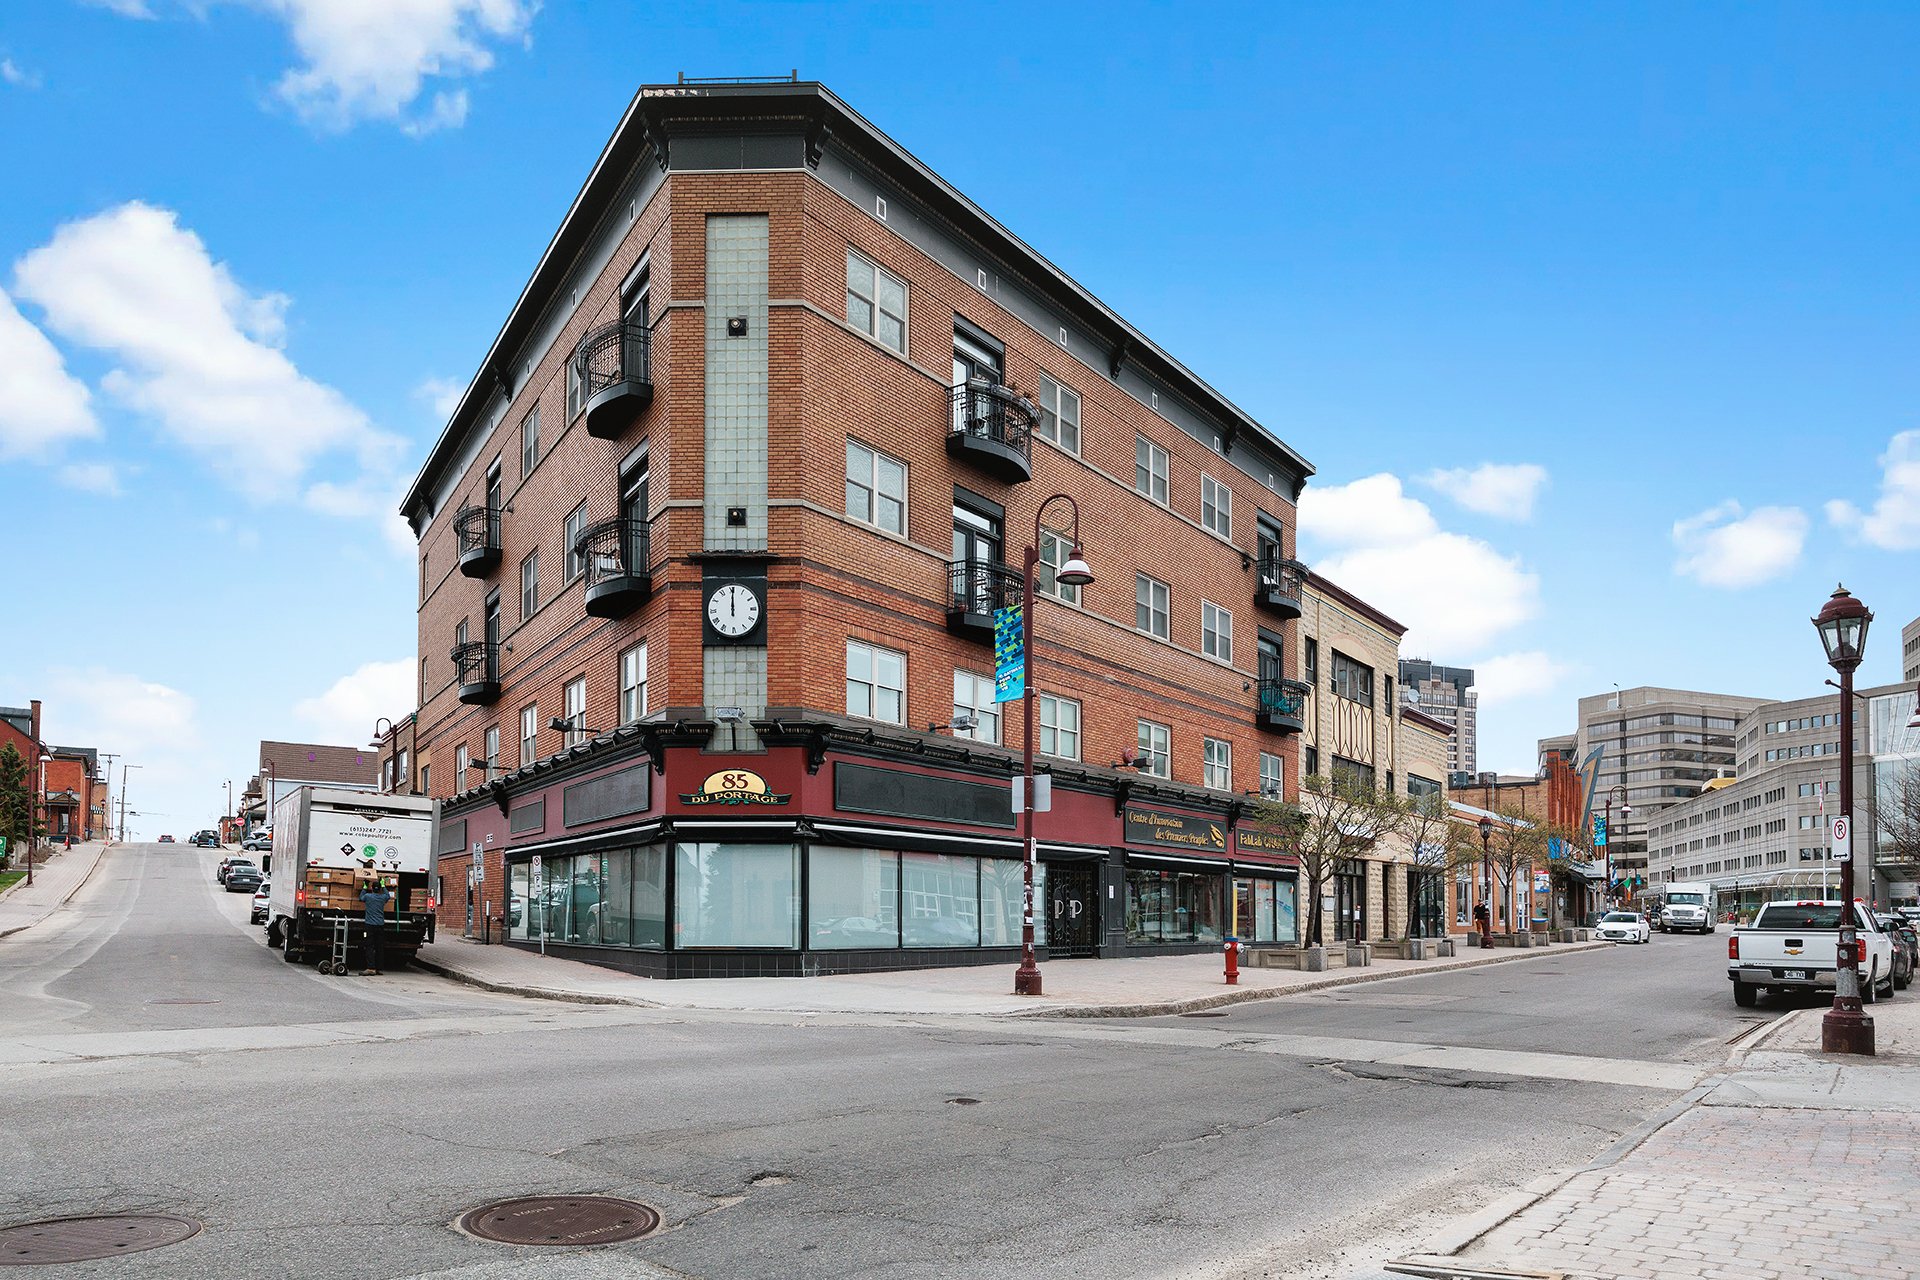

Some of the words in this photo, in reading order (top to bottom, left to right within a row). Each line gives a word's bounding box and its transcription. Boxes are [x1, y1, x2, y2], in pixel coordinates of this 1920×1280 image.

[722, 774, 749, 789] 85
[691, 795, 709, 803] DU
[714, 791, 778, 803] PORTAGE
[1129, 811, 1148, 823] Centre
[1148, 813, 1183, 828] d'Innovation
[1155, 827, 1165, 840] des
[1165, 829, 1188, 843] Premiers
[1188, 832, 1209, 847] Peuples
[1240, 833, 1263, 847] FabLab
